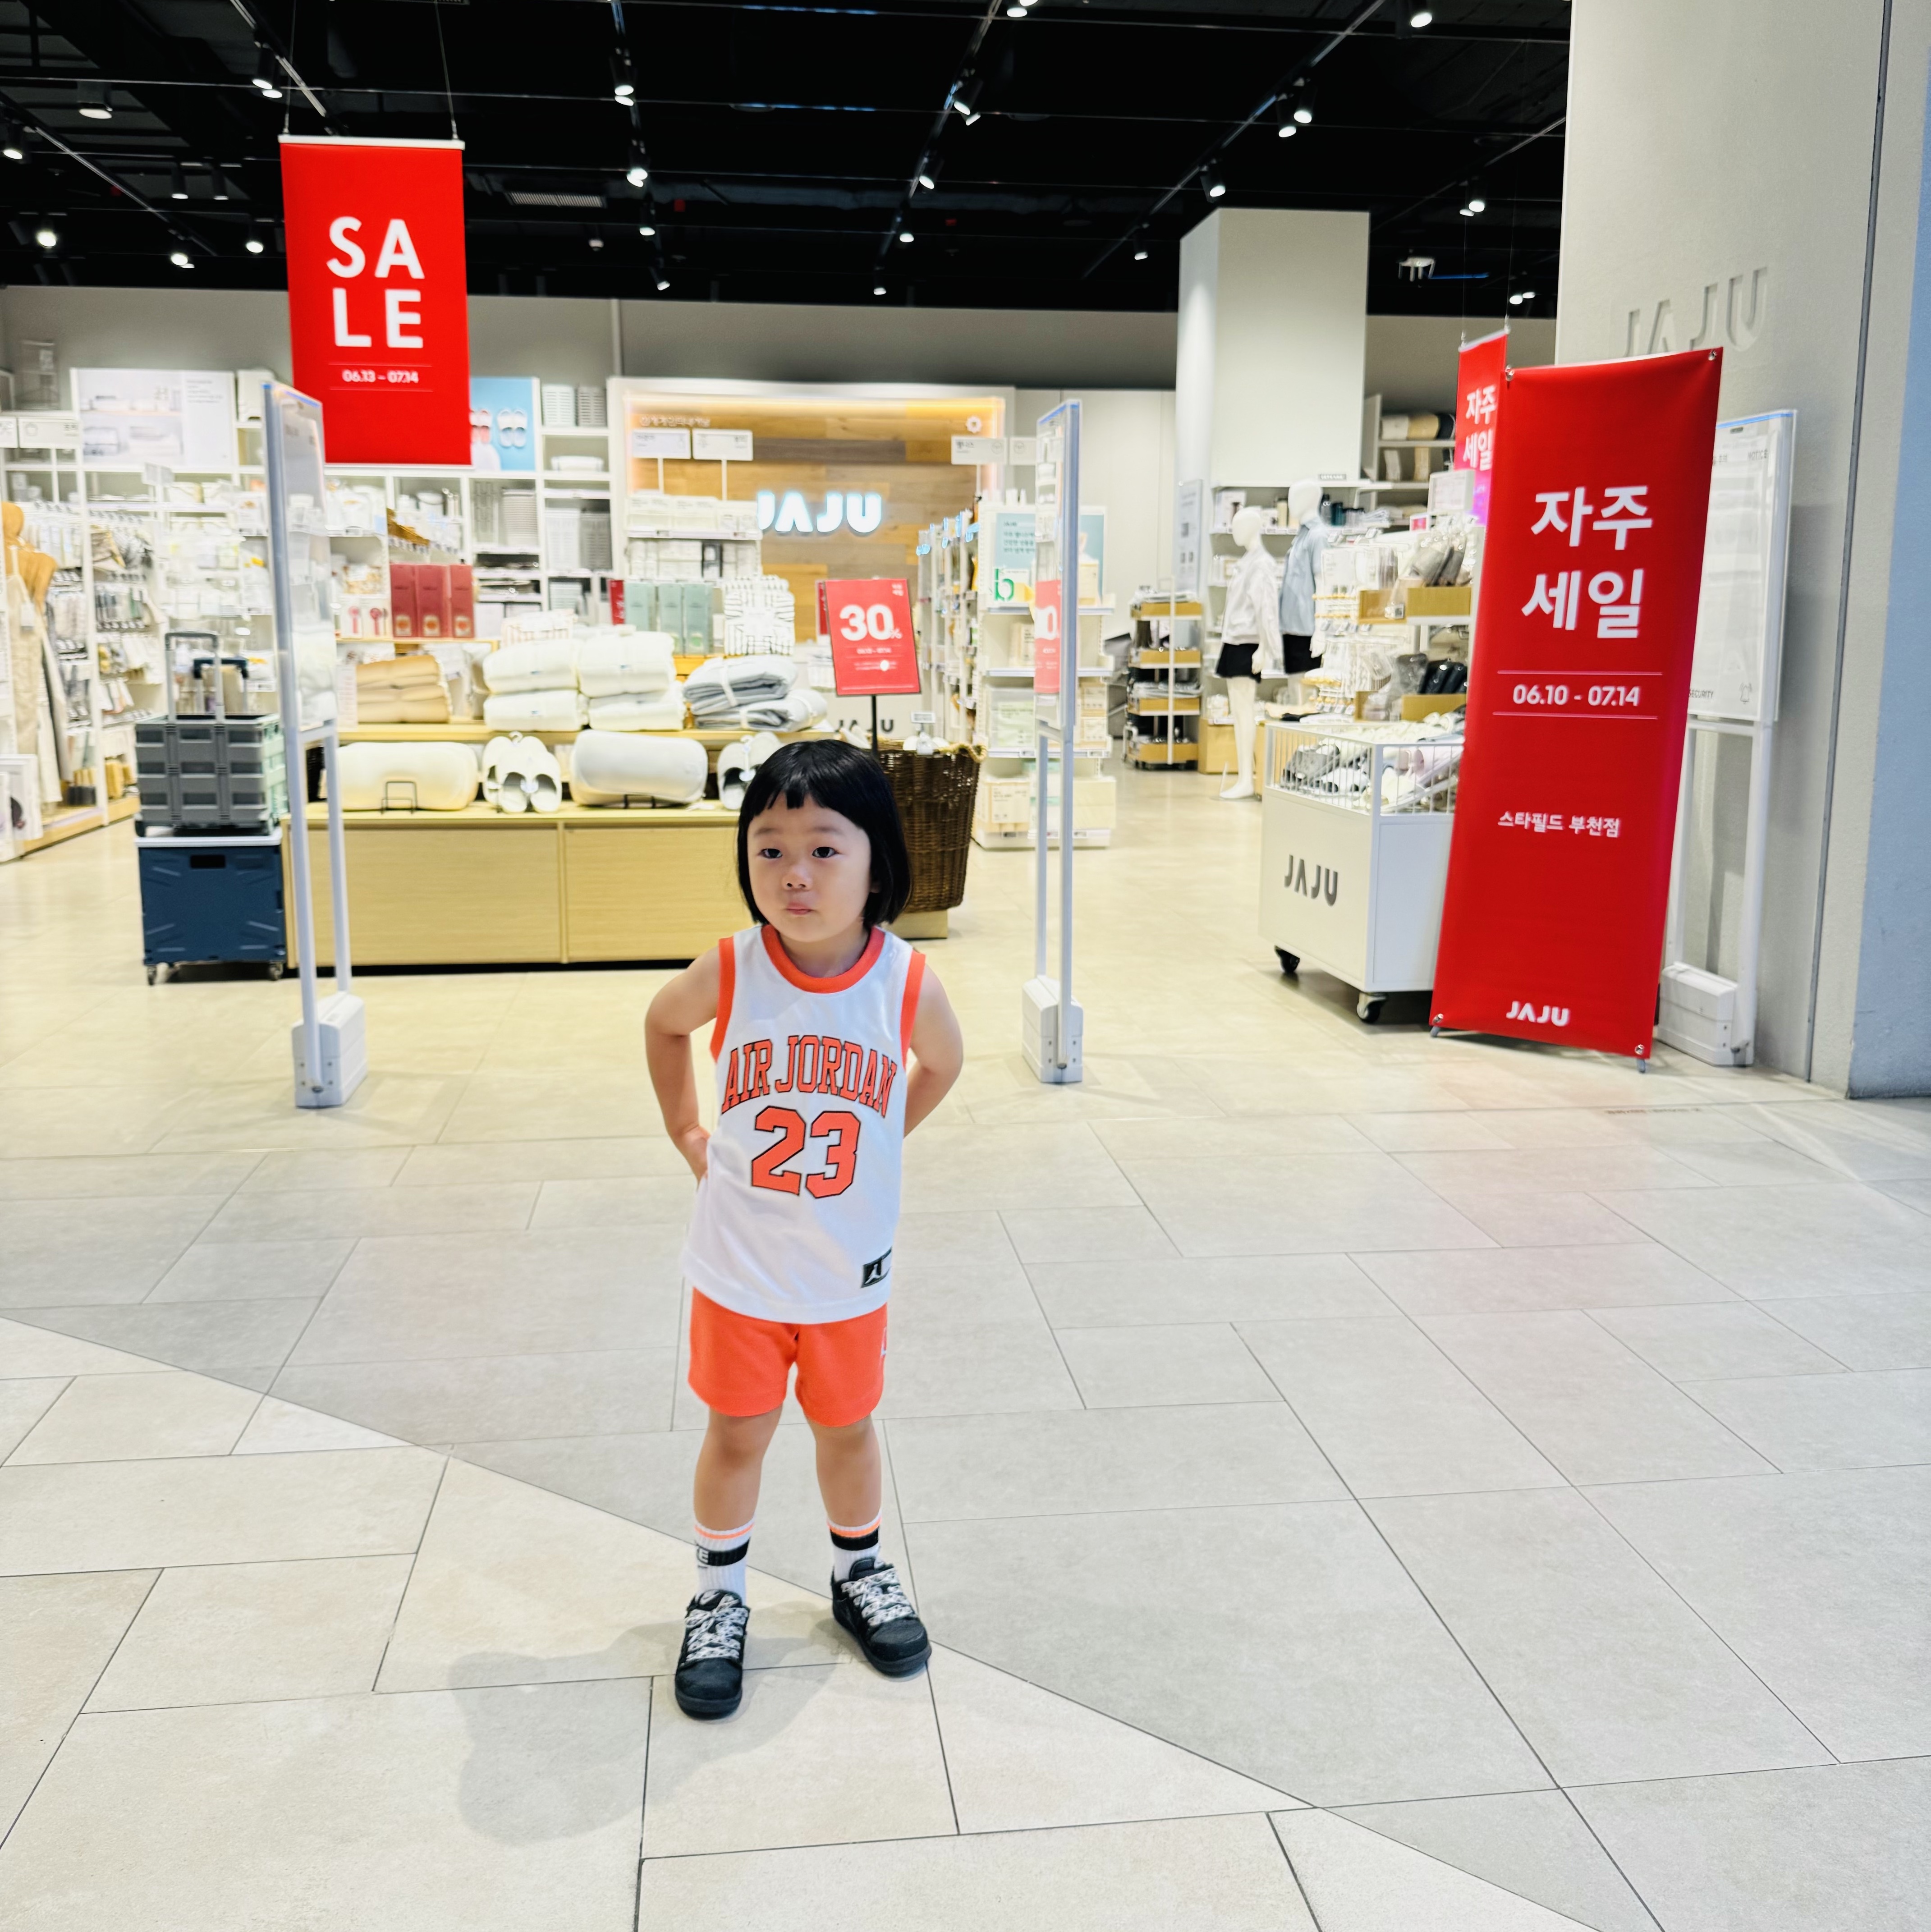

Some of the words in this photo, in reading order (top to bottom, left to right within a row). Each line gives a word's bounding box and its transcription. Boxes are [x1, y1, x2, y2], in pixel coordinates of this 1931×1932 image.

[1466, 385, 1496, 424] 자주
[1463, 430, 1492, 470] 세일
[757, 491, 881, 532] JAJU
[1531, 486, 1652, 550] 자주
[1522, 569, 1644, 638] 세일
[1513, 684, 1569, 705] 06.10
[1588, 685, 1640, 707] 07.14
[1498, 811, 1564, 833] 스타필드
[1569, 816, 1620, 838] 부천점
[1284, 854, 1339, 907] JAJU
[1506, 1000, 1570, 1027] JAJU
[721, 1039, 772, 1114] AIR
[776, 1035, 897, 1119] JORDAN
[752, 1105, 861, 1199] 23
